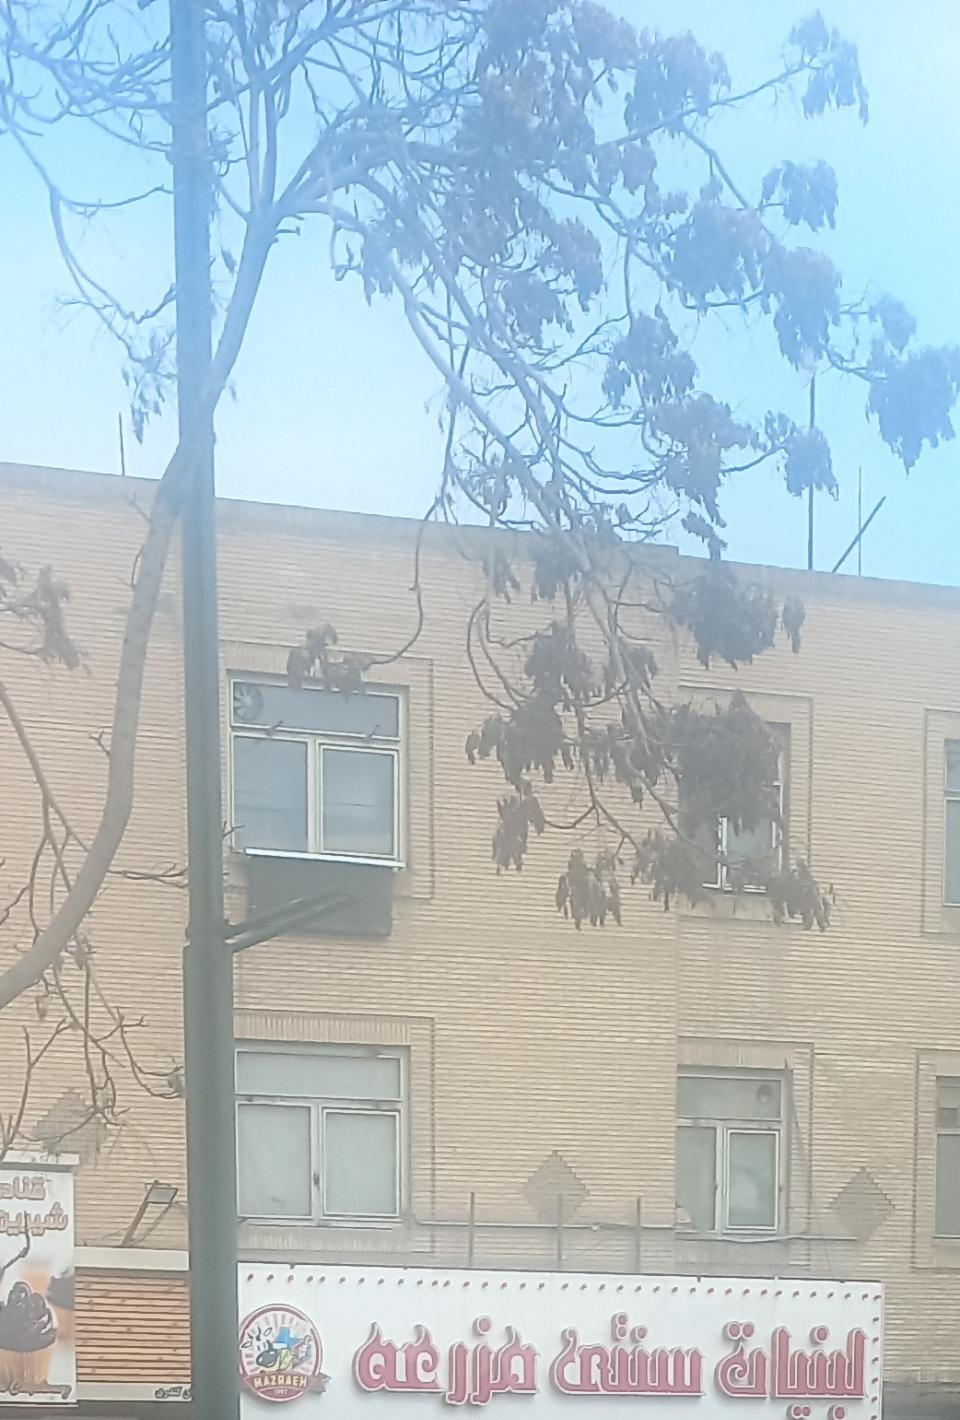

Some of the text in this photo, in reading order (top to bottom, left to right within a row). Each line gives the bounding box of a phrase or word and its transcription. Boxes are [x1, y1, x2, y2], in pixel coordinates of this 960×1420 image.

[254, 1375, 307, 1388] MAZRAEH
[352, 1312, 869, 1420] لبنیات سنتی مزرعه
